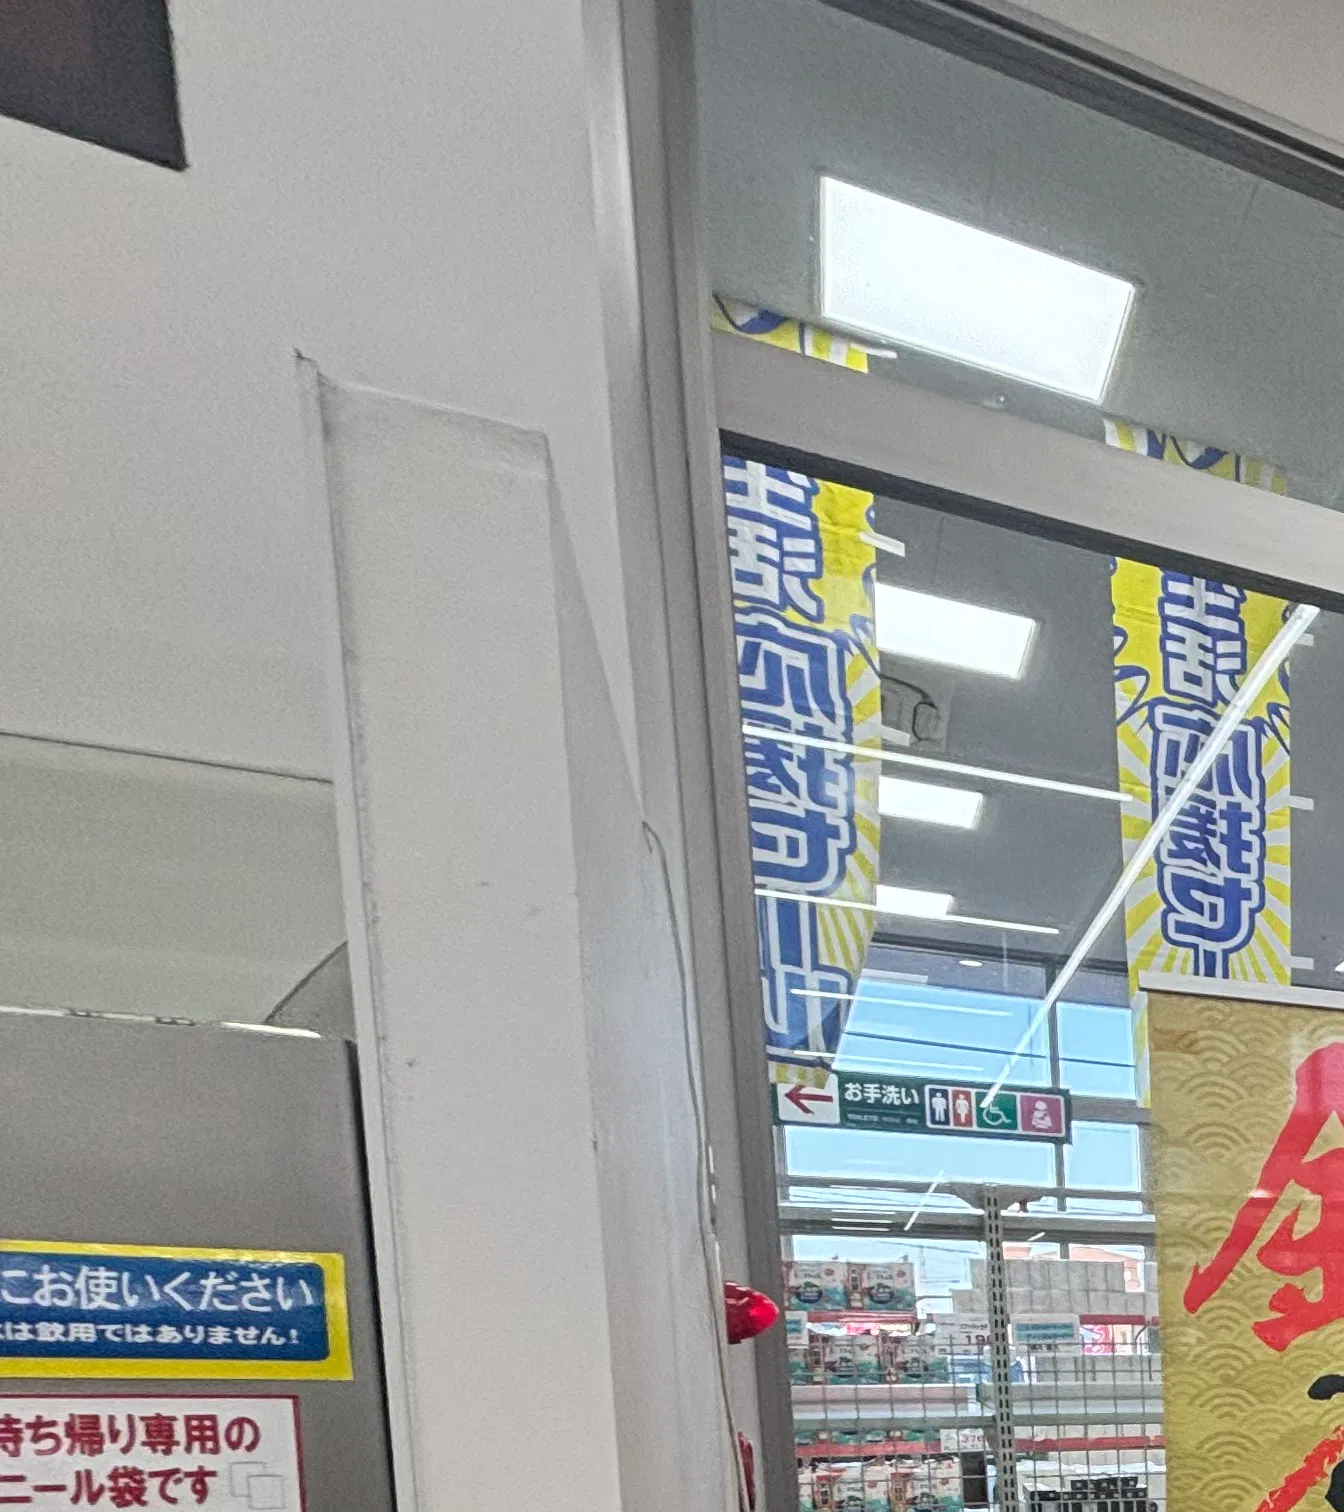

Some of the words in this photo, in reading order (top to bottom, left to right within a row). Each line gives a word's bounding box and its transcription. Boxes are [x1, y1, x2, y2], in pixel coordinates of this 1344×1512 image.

[843, 1082, 920, 1106] お手洗い
[0, 1321, 300, 1347] は飲用ではありません!
[0, 1466, 217, 1508] ニール袋です
